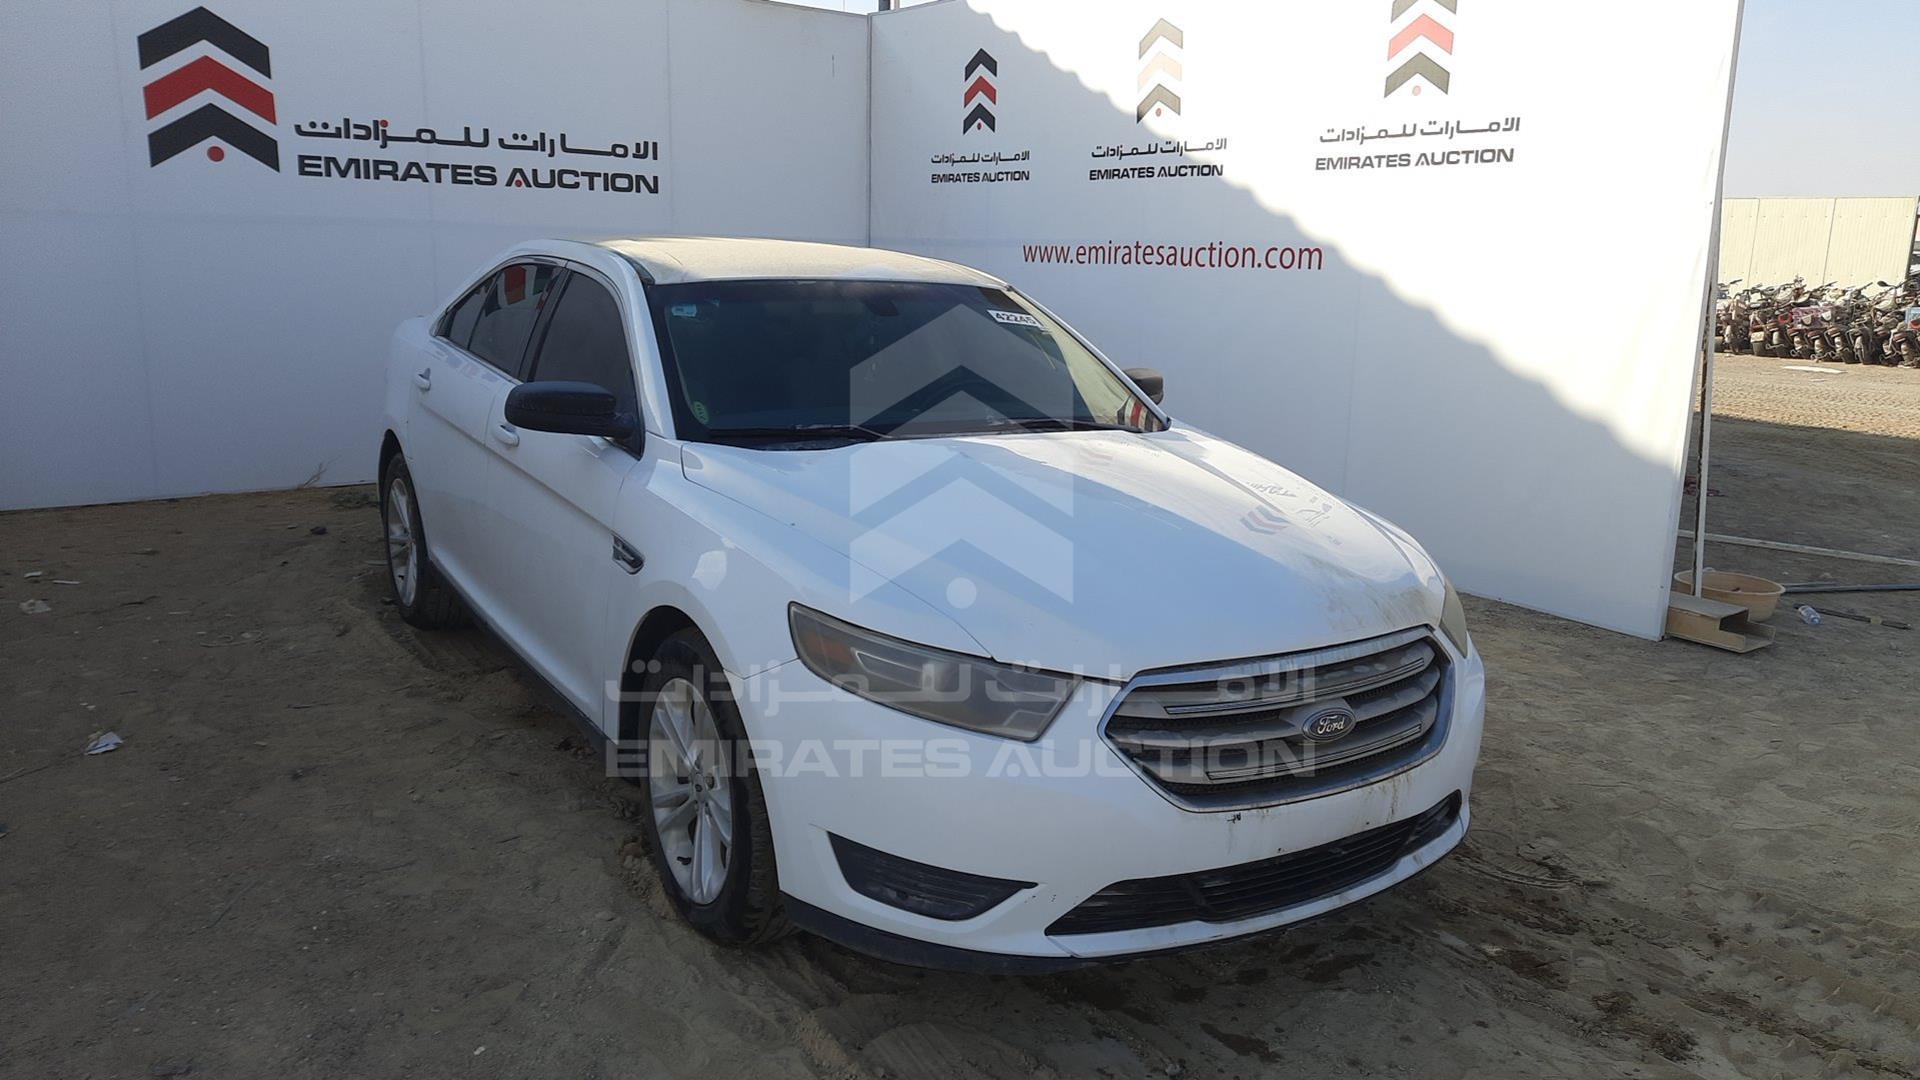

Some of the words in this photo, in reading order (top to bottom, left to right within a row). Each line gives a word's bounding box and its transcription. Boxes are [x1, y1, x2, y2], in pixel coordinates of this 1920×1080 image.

[1315, 153, 1412, 172] EMIRATES
[1414, 148, 1515, 168] AUCTION
[298, 154, 498, 187] EMIRATES
[504, 168, 659, 195] AUCTION
[931, 172, 981, 184] EMIRATES
[981, 171, 1030, 183] AUCTION
[1089, 167, 1156, 181] EMIRATES
[1157, 164, 1224, 178] AUCTION
[1022, 240, 1324, 271] www.emiratesauction.com
[994, 311, 1037, 325] 42245
[1317, 714, 1346, 735] Ford
